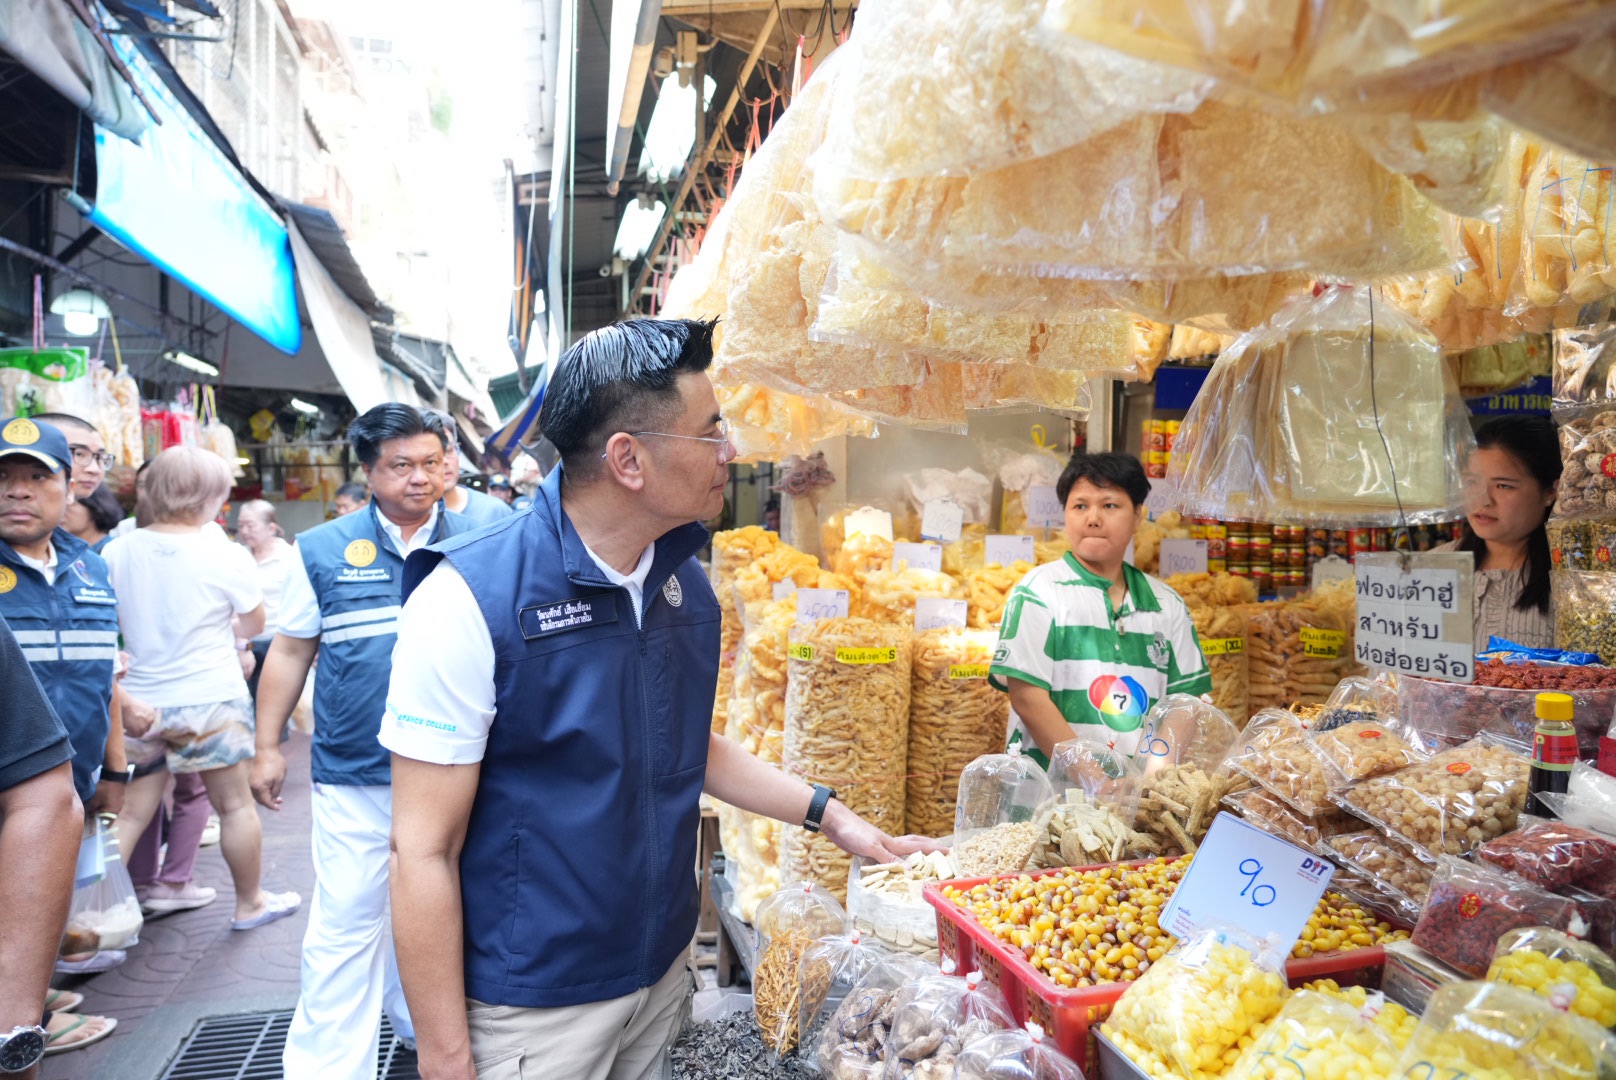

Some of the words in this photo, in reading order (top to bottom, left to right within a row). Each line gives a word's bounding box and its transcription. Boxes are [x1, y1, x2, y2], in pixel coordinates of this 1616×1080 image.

[1360, 612, 1438, 640] สำหรับ
[1357, 642, 1467, 678] ห่อฮ่อยจ้อ
[1113, 694, 1127, 709] 7
[1239, 858, 1276, 906] 90
